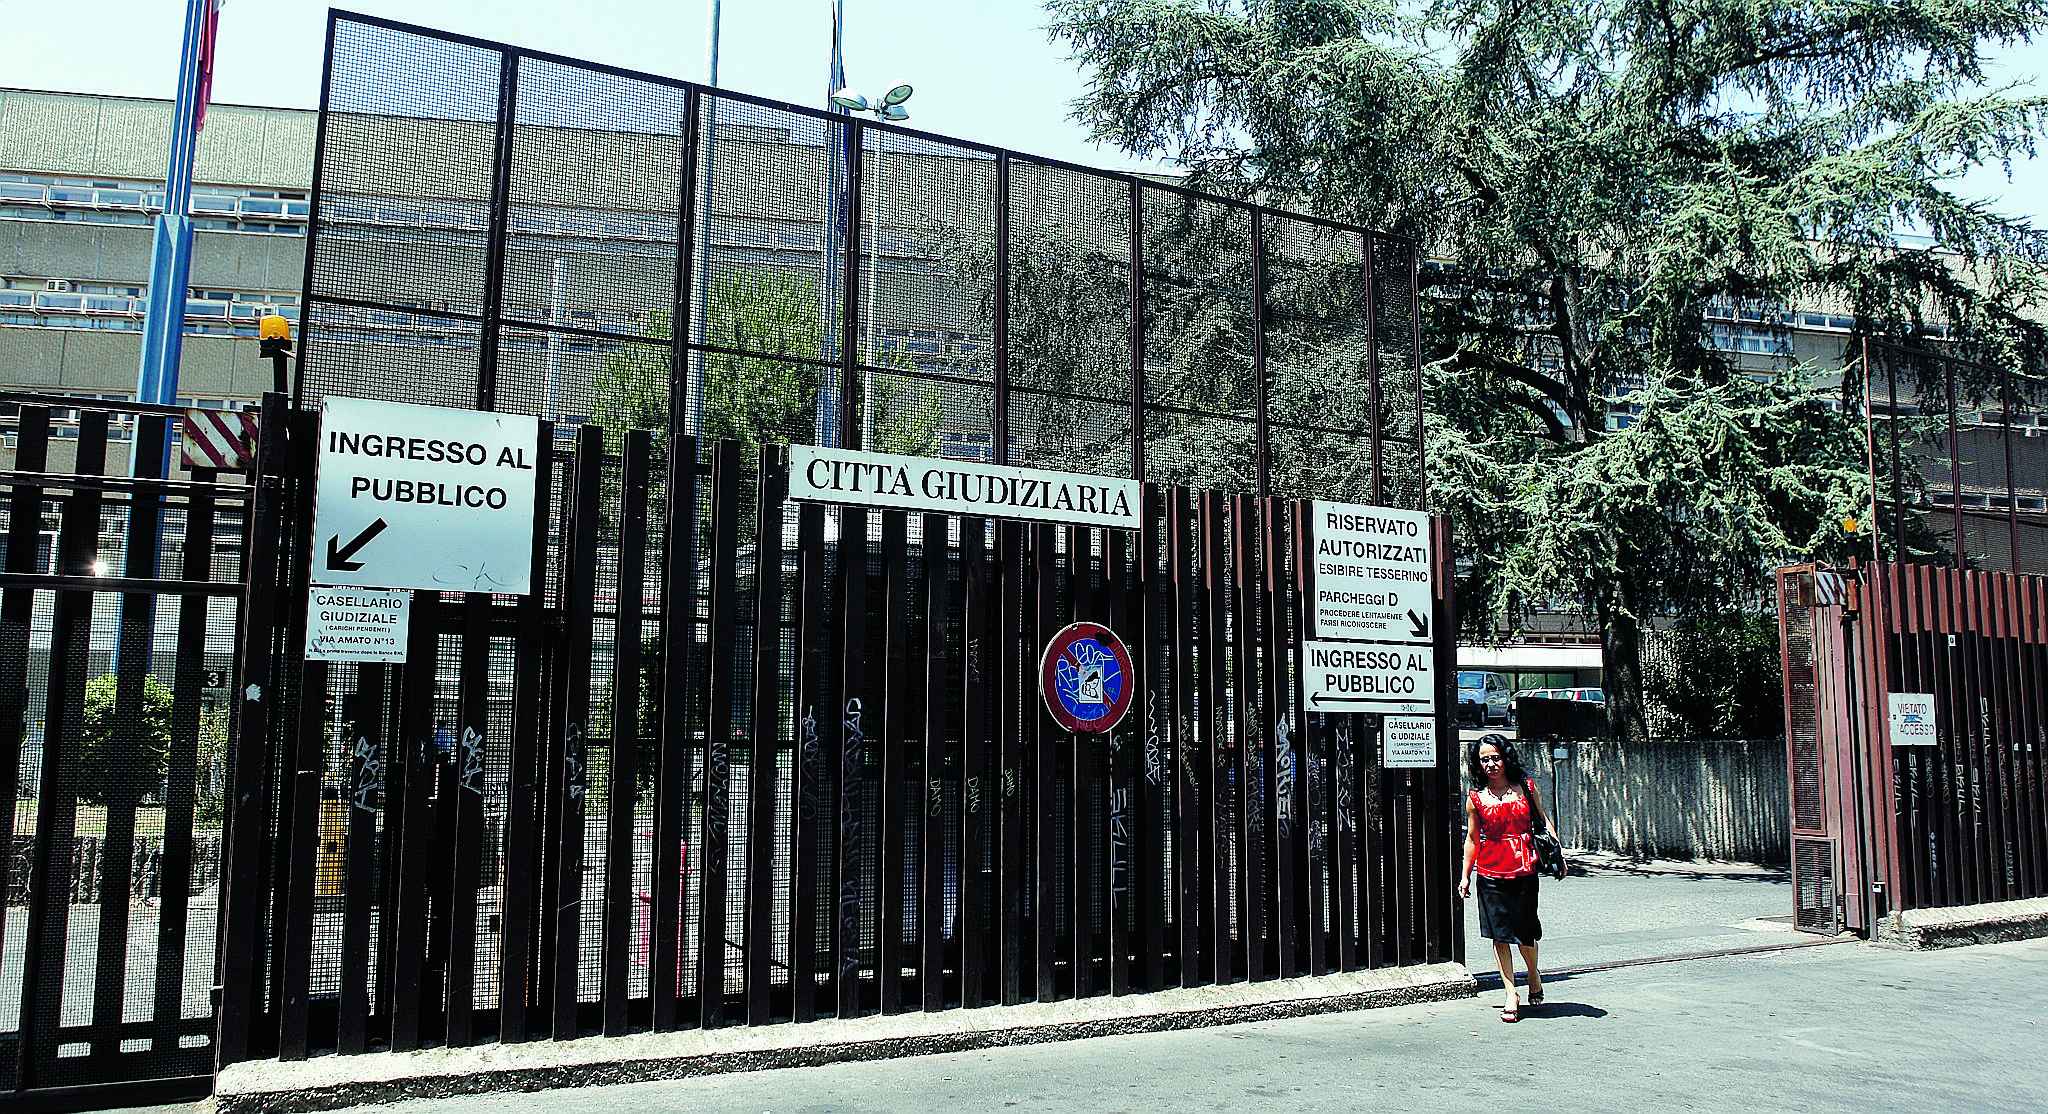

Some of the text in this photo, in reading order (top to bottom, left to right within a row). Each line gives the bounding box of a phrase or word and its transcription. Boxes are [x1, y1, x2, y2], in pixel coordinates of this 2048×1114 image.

[329, 431, 532, 470] INGRESSO AL
[351, 476, 507, 509] PUBBLICO
[806, 459, 1133, 517] CITTÀ GIUDIZIARIA
[1326, 512, 1418, 537] RISERVATO
[1319, 538, 1427, 564] AUTORIZZATI
[1319, 563, 1428, 583] ESIBIRE TESSERINO
[316, 595, 403, 609] CASELLARIO
[1319, 590, 1398, 607] PARCHEGGI D
[320, 611, 398, 624] GIUDIZIALE
[1320, 608, 1403, 620] PROCEDERE LENTAMENTE
[1320, 619, 1387, 630] FARSI RICONOSCERE
[319, 635, 335, 643] VIA
[337, 636, 371, 645] AMATO
[1311, 649, 1428, 671] INGRESSO AL
[1325, 674, 1415, 694] PUBBLICO
[1897, 703, 1928, 715] VIETATO
[1388, 721, 1432, 730] CASELLARIO
[1390, 732, 1430, 741] GUDIZIALE
[930, 777, 942, 817] DAMO
[967, 776, 980, 813] DAMO
[1111, 787, 1128, 908] SKULL
